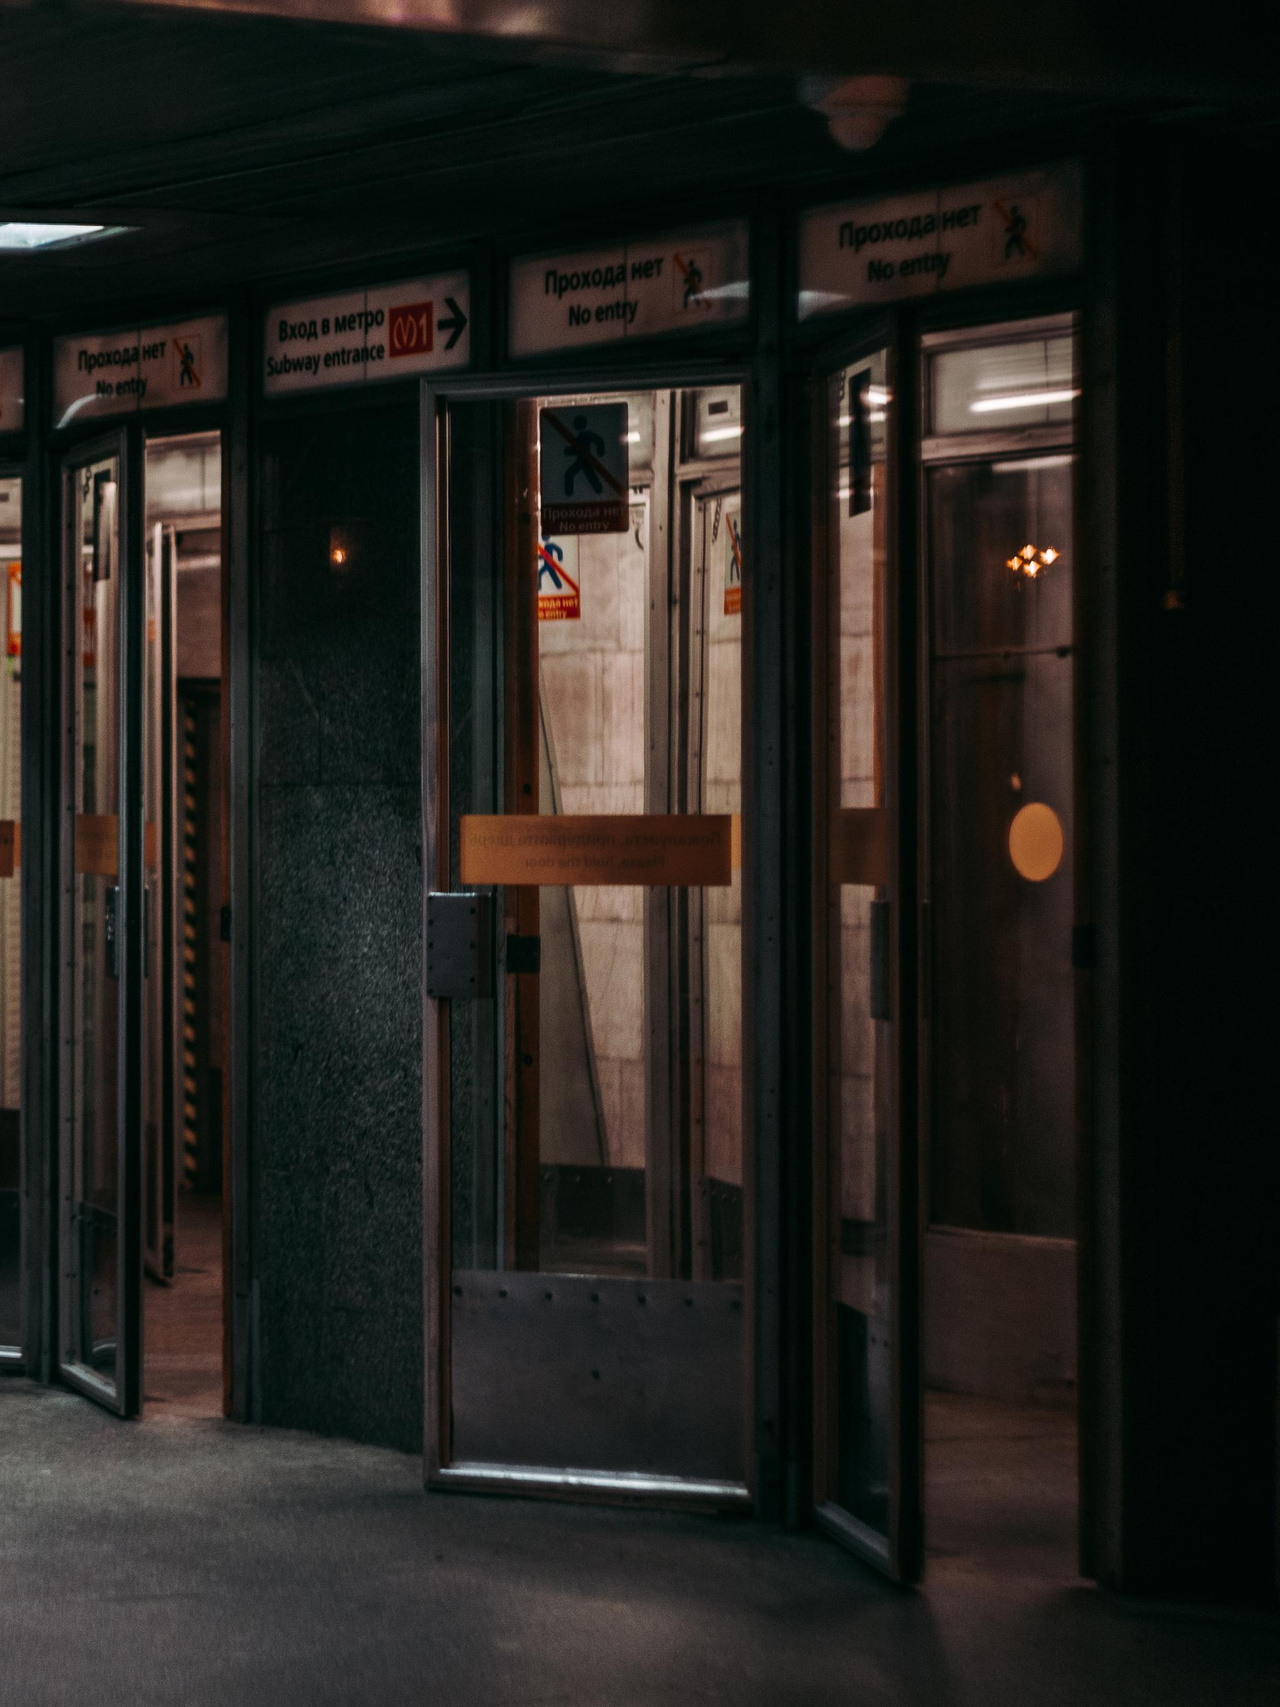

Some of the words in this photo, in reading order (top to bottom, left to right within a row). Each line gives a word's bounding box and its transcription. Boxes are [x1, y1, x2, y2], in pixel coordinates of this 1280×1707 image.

[838, 214, 936, 253] Прохода
[941, 205, 982, 230] нет
[544, 264, 627, 298] Прохода
[631, 257, 664, 280] нет
[867, 260, 894, 281] No
[899, 253, 951, 278] entry
[278, 320, 318, 341] Вход
[322, 318, 330, 335] в
[335, 309, 385, 334] метро
[568, 306, 591, 326] No
[595, 300, 638, 323] entry
[78, 346, 139, 374] Прохода
[143, 341, 167, 360] нет
[267, 354, 320, 376] Subway
[324, 344, 385, 368] entrance
[96, 380, 113, 395] No
[116, 376, 148, 397] entry
[543, 507, 600, 523] Прохода
[559, 520, 576, 532] No
[578, 520, 610, 531] entry
